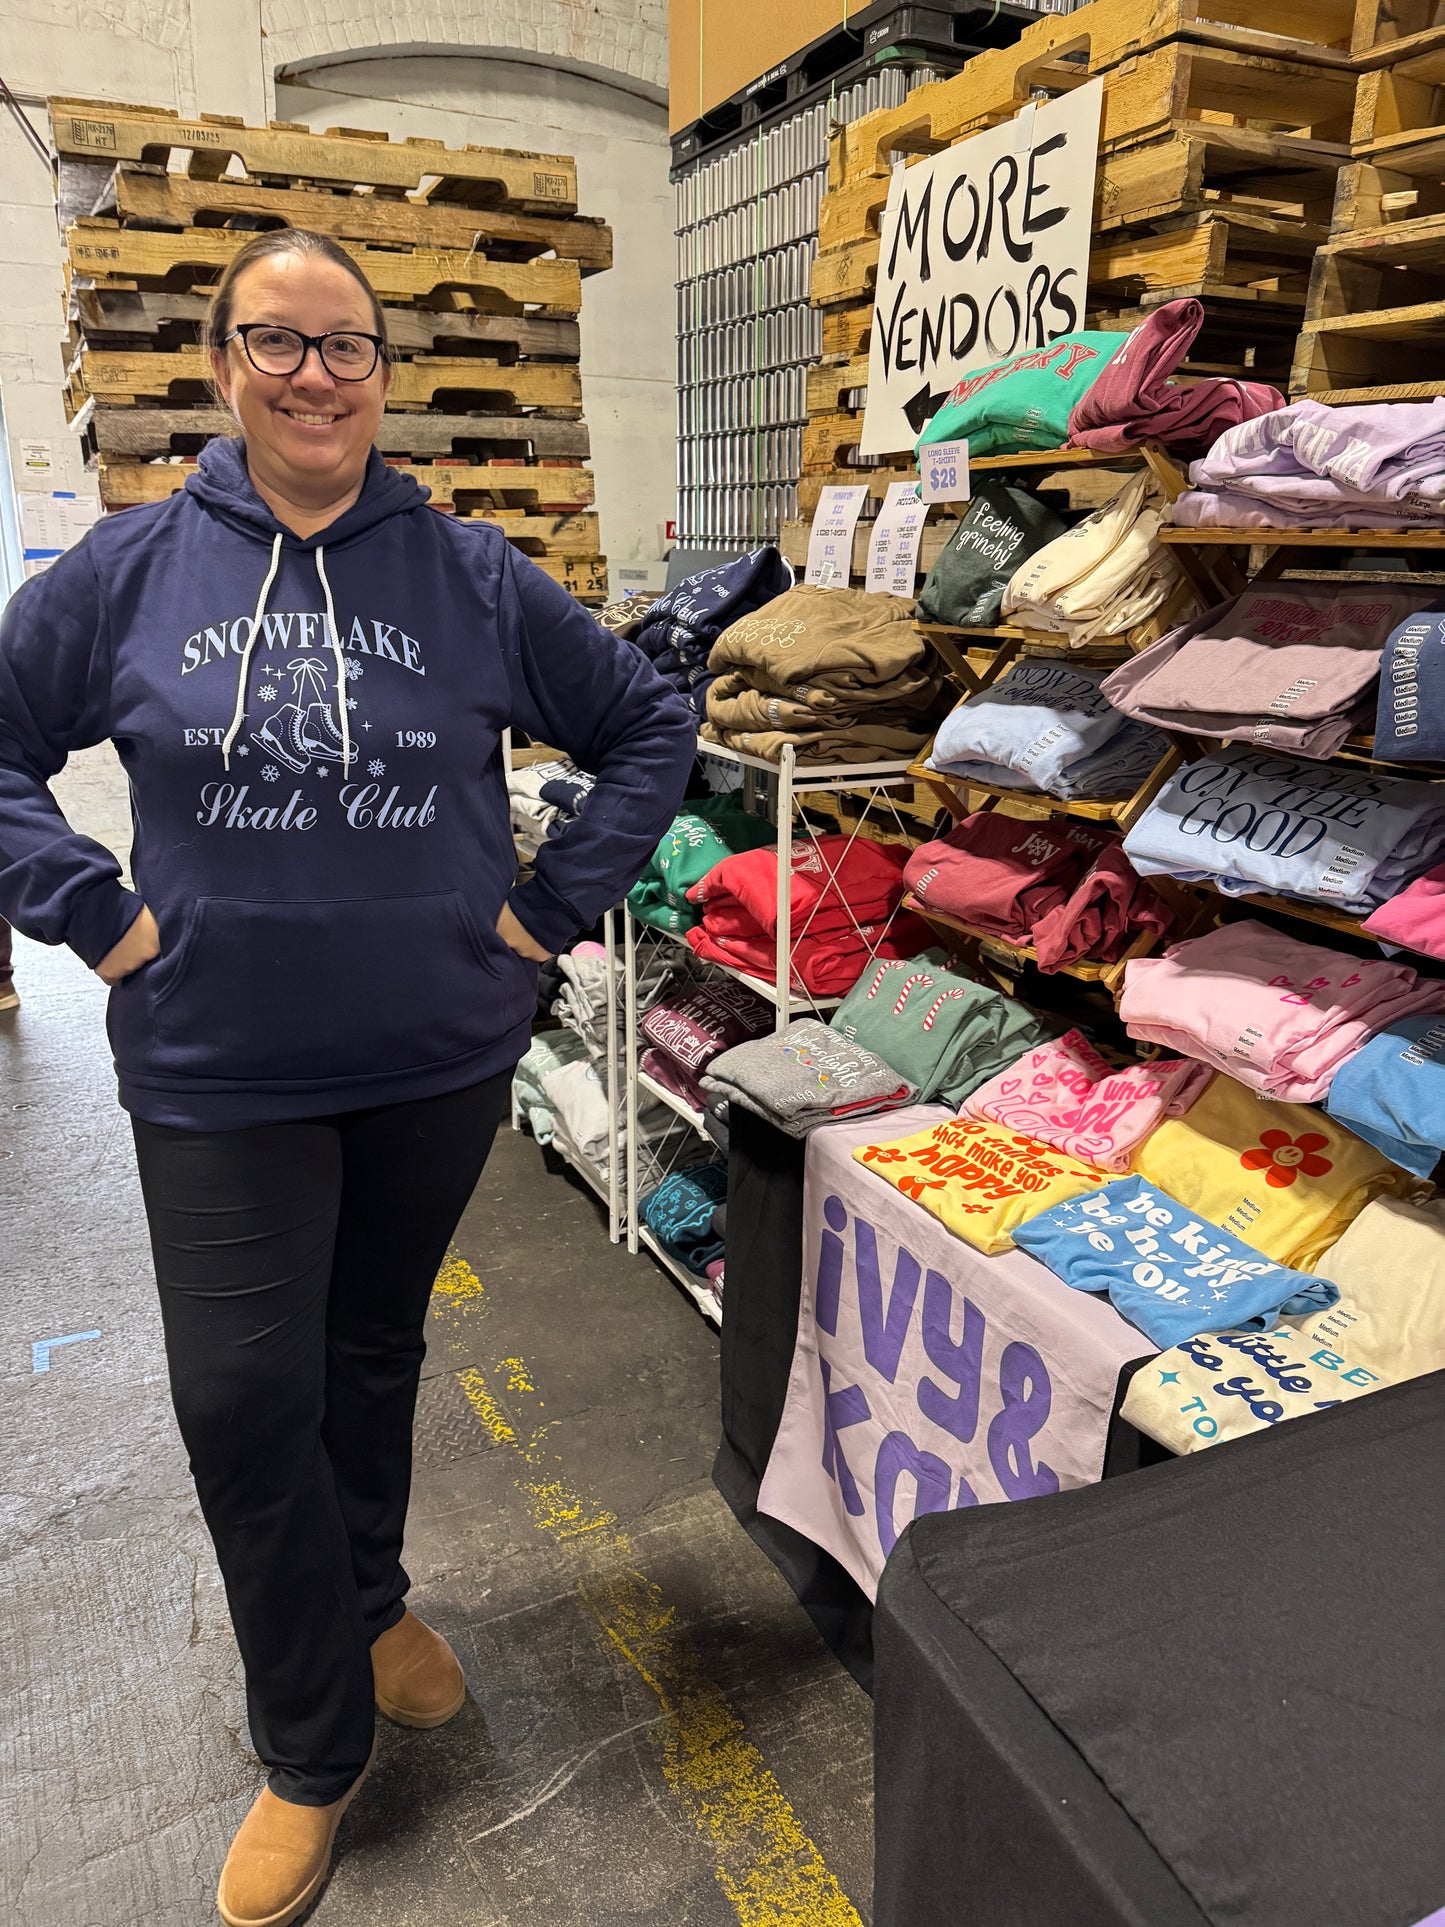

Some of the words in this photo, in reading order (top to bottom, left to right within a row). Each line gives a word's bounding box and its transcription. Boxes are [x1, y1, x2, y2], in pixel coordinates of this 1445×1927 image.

[888, 133, 1071, 283] MORE
[875, 264, 1078, 382] VENDORS
[930, 467, 957, 490] $28
[972, 502, 1025, 551] feeling
[956, 530, 1013, 571] grinchy
[181, 613, 426, 676] SNOWFLAKE
[1394, 670, 1416, 679] Medium
[1395, 684, 1417, 693] Medium
[1395, 698, 1417, 707] Medium
[1396, 713, 1417, 721] Medium
[183, 728, 225, 746] EST
[395, 730, 437, 749] 1989
[1396, 726, 1417, 735] Medium
[1224, 752, 1395, 797] FOCUS
[197, 782, 318, 831] Skate
[339, 783, 438, 830] Club
[1180, 765, 1275, 797] ON
[1264, 783, 1387, 829] THE
[1178, 797, 1328, 859] GOOD
[1334, 855, 1358, 866] Medium
[1341, 845, 1365, 857] Medium
[1328, 866, 1351, 875] Medium
[817, 1052, 861, 1088] lights
[908, 1143, 1026, 1200] happy
[932, 1124, 968, 1149] that
[965, 1142, 1015, 1178] make
[1012, 1166, 1051, 1192] you
[981, 1137, 1064, 1177] things
[1079, 1193, 1128, 1226] be
[1228, 1215, 1246, 1231] Medium
[1236, 1206, 1254, 1223] Medium
[1243, 1197, 1262, 1214] Medium
[1124, 1192, 1173, 1227] be
[1169, 1221, 1284, 1276] kind
[1110, 1260, 1190, 1300] ou
[1319, 1323, 1339, 1337] Medium
[1327, 1315, 1348, 1328] Medium
[1312, 1333, 1333, 1348] Medium
[1177, 1338, 1223, 1372] to
[1213, 1376, 1284, 1425] yo
[1216, 1334, 1312, 1393] little
[1309, 1349, 1380, 1387] BE
[1180, 1396, 1224, 1444] TO
